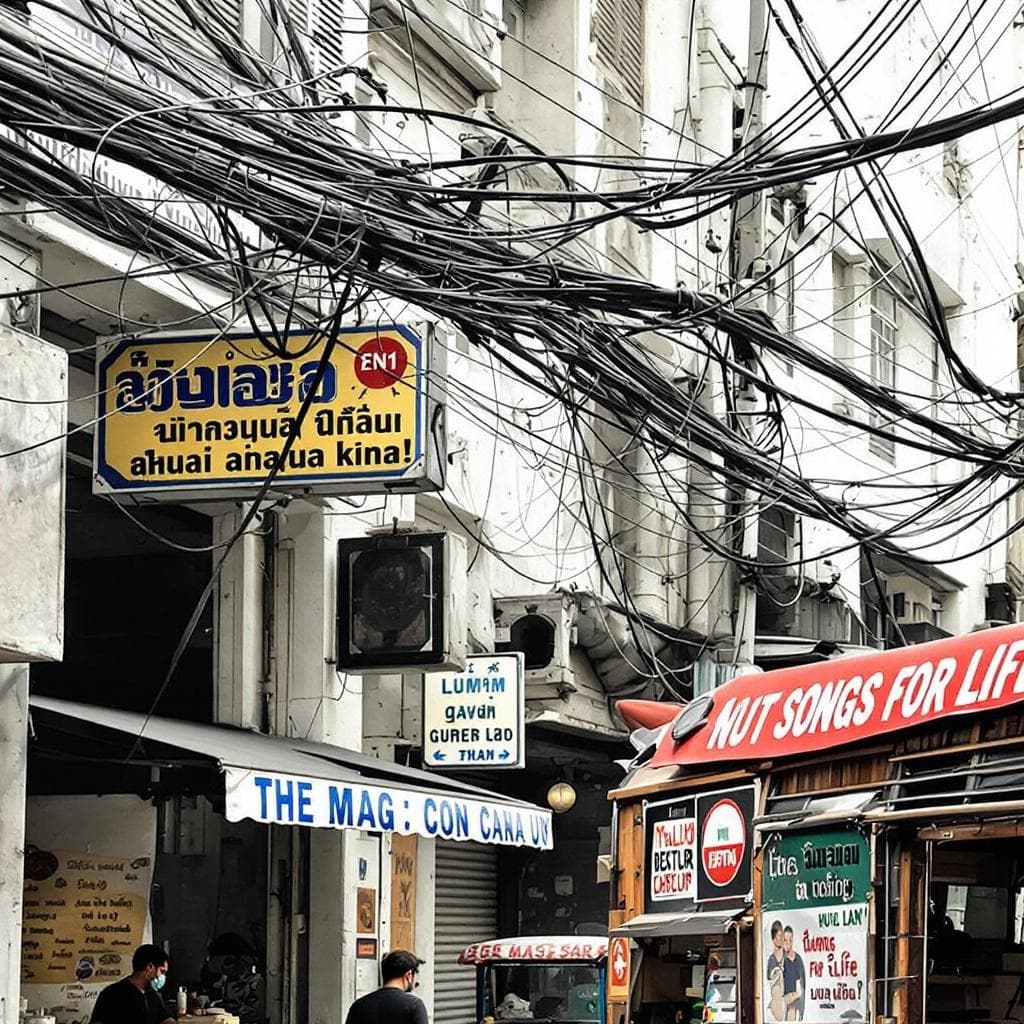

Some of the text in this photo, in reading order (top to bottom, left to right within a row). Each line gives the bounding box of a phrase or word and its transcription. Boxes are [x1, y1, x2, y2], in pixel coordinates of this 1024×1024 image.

[707, 692, 784, 750] NUT
[773, 671, 885, 742] SONGS
[880, 656, 957, 721] FOR
[255, 776, 314, 823] THE
[329, 786, 395, 830] MAG
[423, 797, 468, 837] CON
